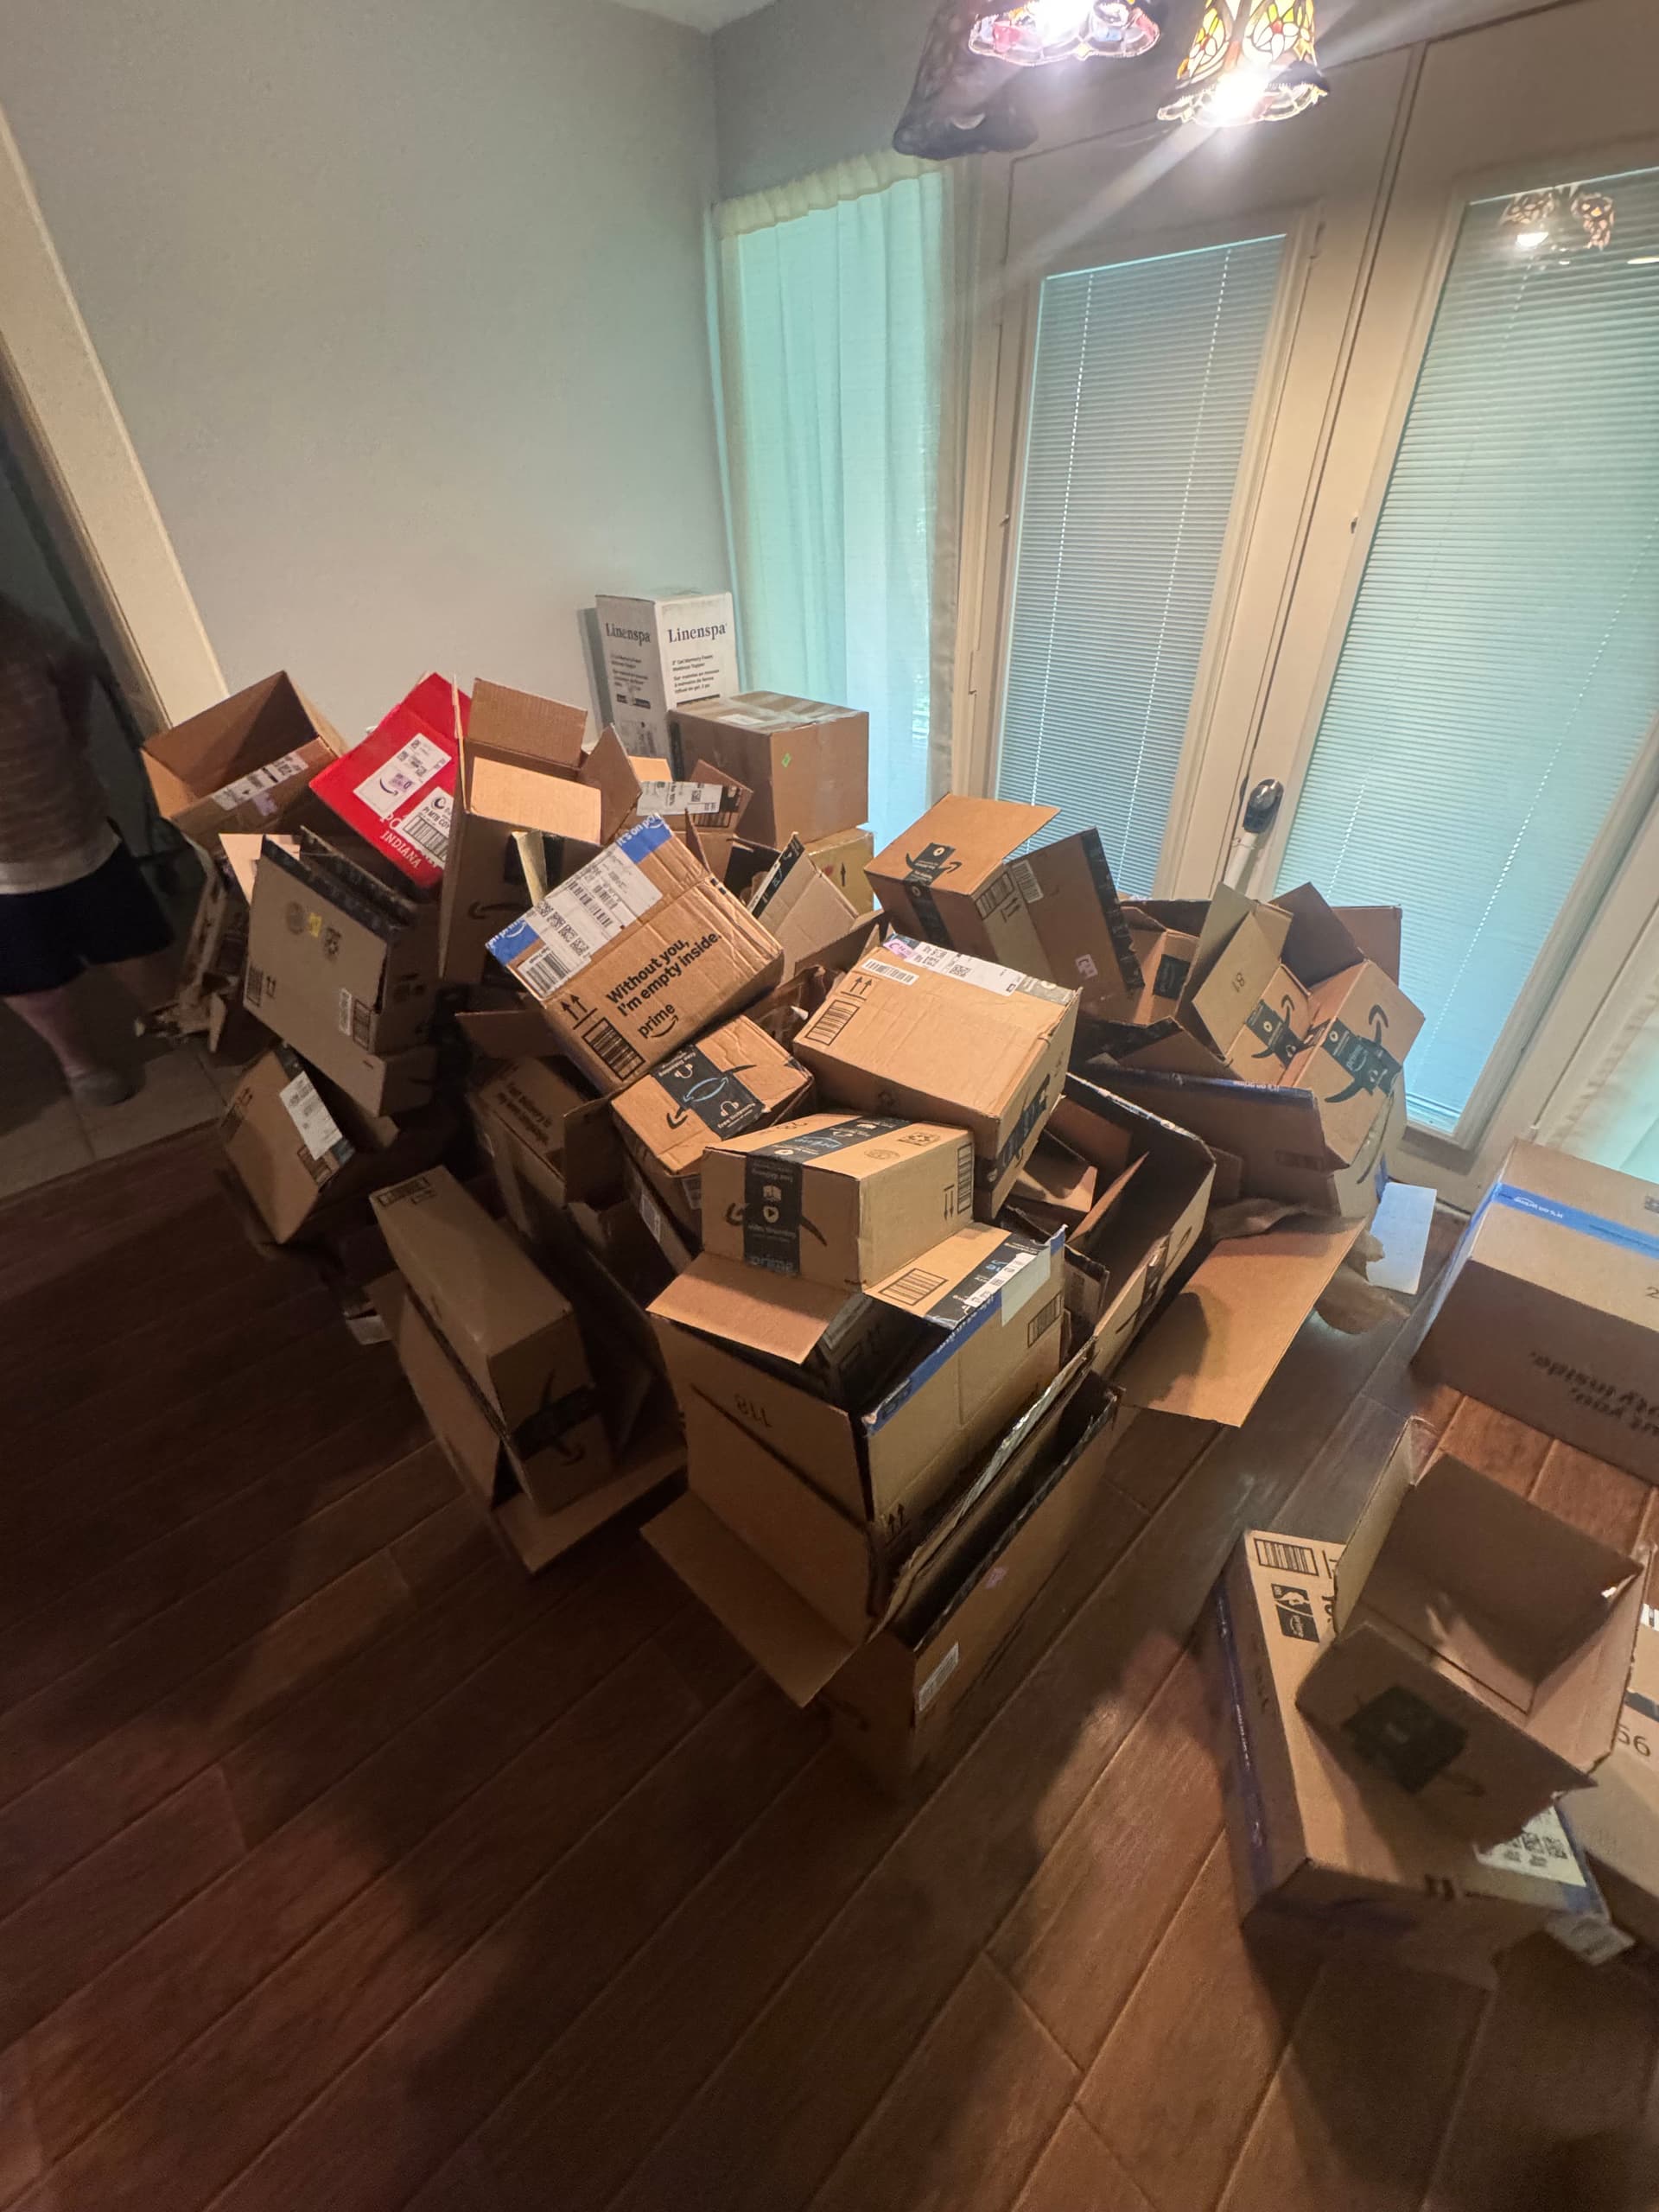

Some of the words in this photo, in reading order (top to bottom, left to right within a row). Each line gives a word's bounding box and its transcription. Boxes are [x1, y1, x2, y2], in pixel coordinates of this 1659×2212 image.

[606, 622, 651, 646] Linenspa
[668, 623, 727, 643] Linenspa
[380, 830, 423, 868] INDIANA
[606, 957, 663, 1004] Without
[659, 939, 690, 965] you,
[617, 996, 642, 1017] I'm
[640, 963, 683, 1000] empty
[677, 932, 722, 967] inside.
[637, 1004, 676, 1039] prime
